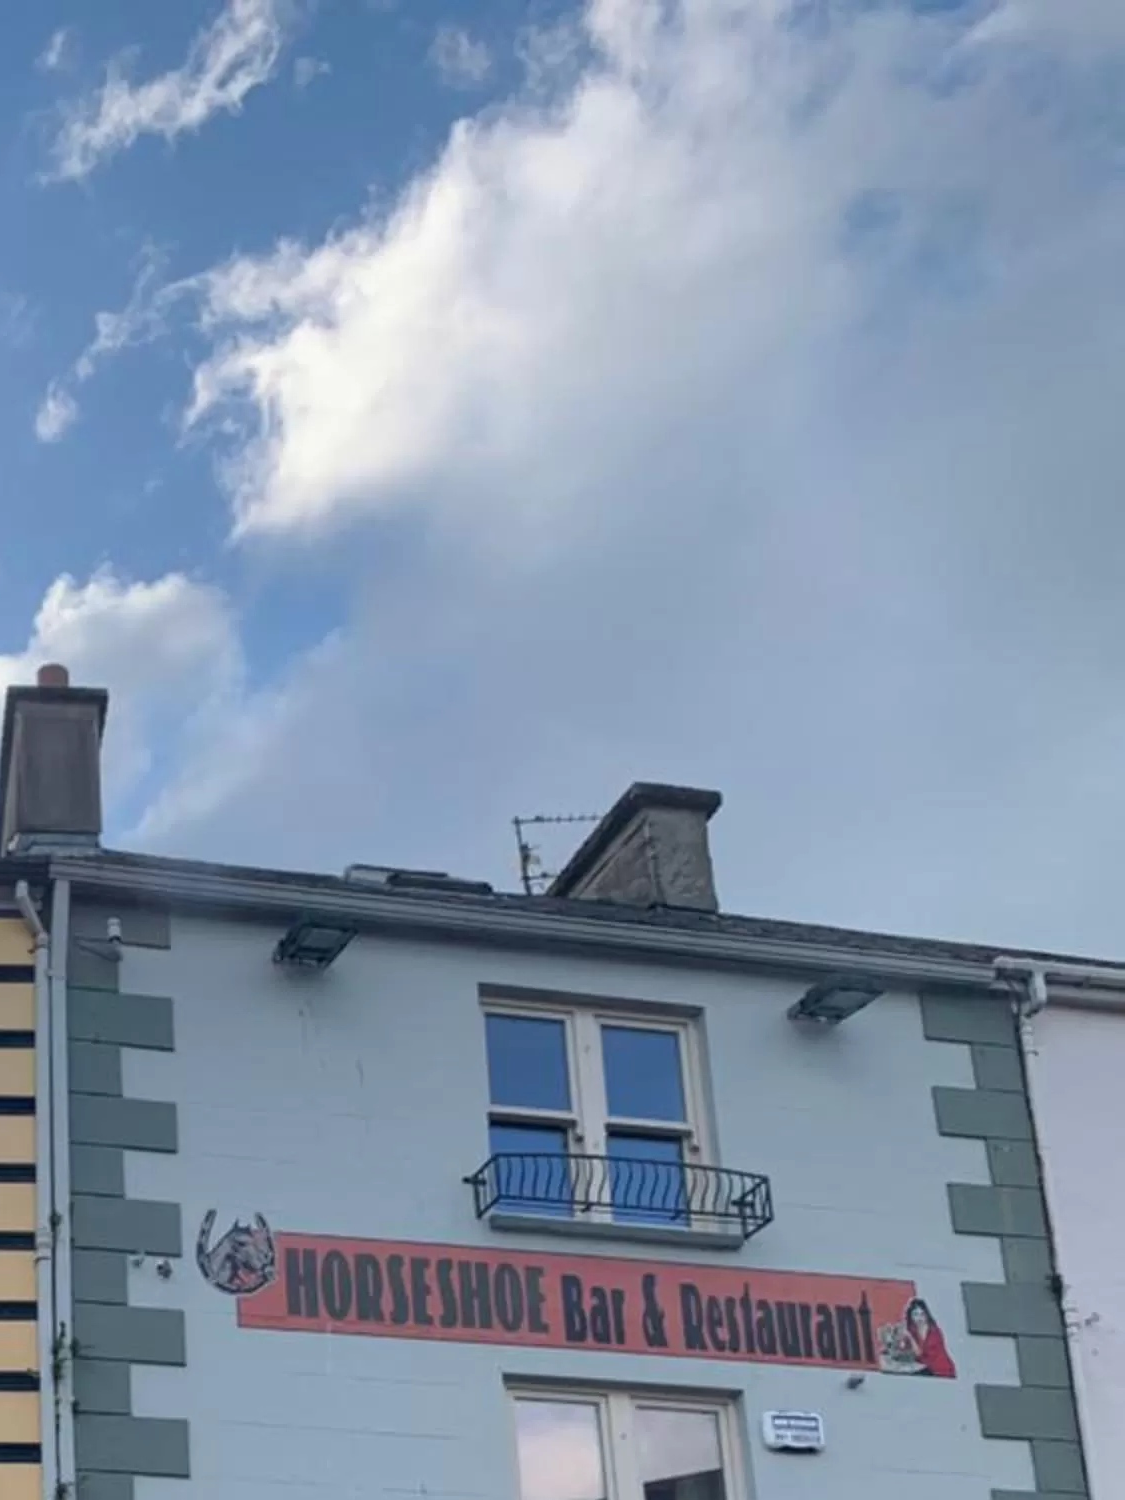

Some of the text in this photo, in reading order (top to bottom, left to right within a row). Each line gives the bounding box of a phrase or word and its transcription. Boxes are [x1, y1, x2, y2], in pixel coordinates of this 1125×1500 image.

[282, 1246, 877, 1364] HORSESHOE Bar & Restaurant
